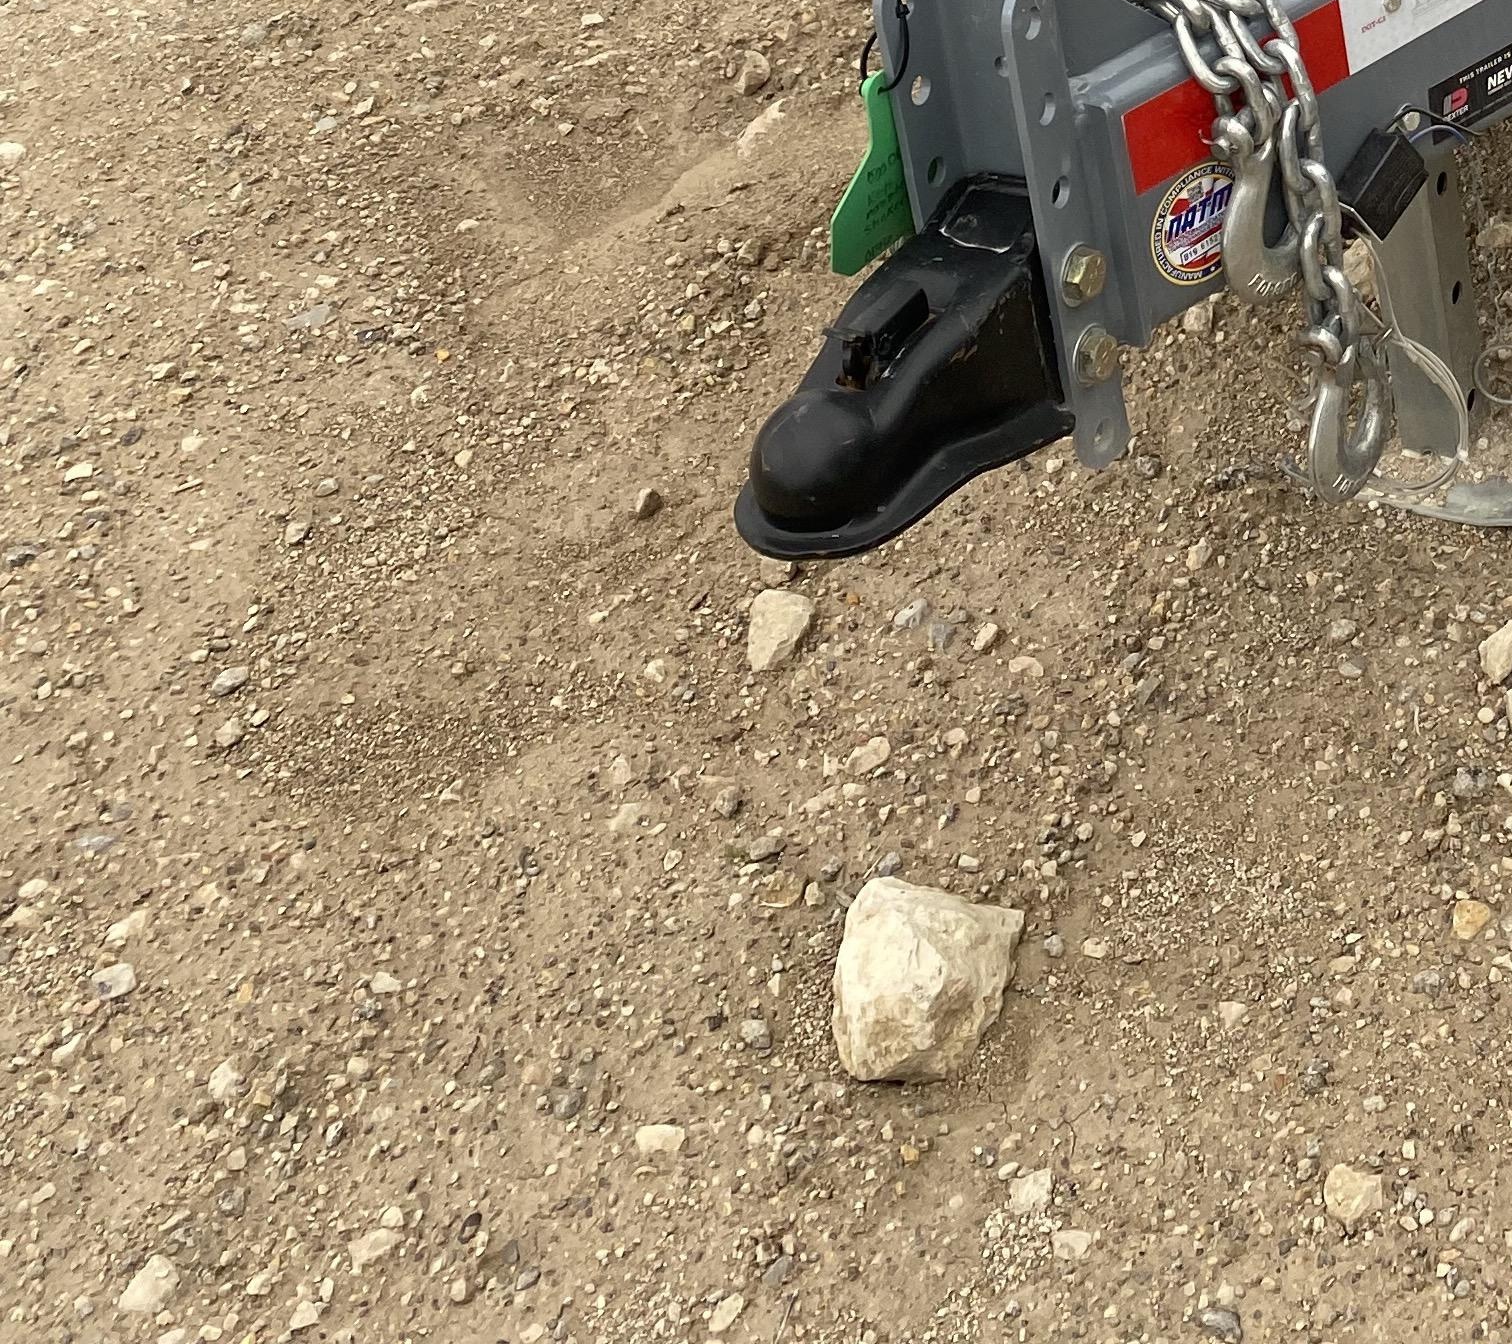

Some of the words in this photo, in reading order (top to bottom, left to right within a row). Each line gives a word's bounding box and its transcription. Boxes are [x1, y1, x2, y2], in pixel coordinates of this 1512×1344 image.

[1459, 72, 1475, 84] THIS
[1475, 56, 1503, 75] TRAILER
[1503, 51, 1511, 60] IS
[1160, 167, 1212, 215] COMPLIANCE
[1155, 217, 1165, 230] IN
[1155, 232, 1202, 281] MANUFACTURED
